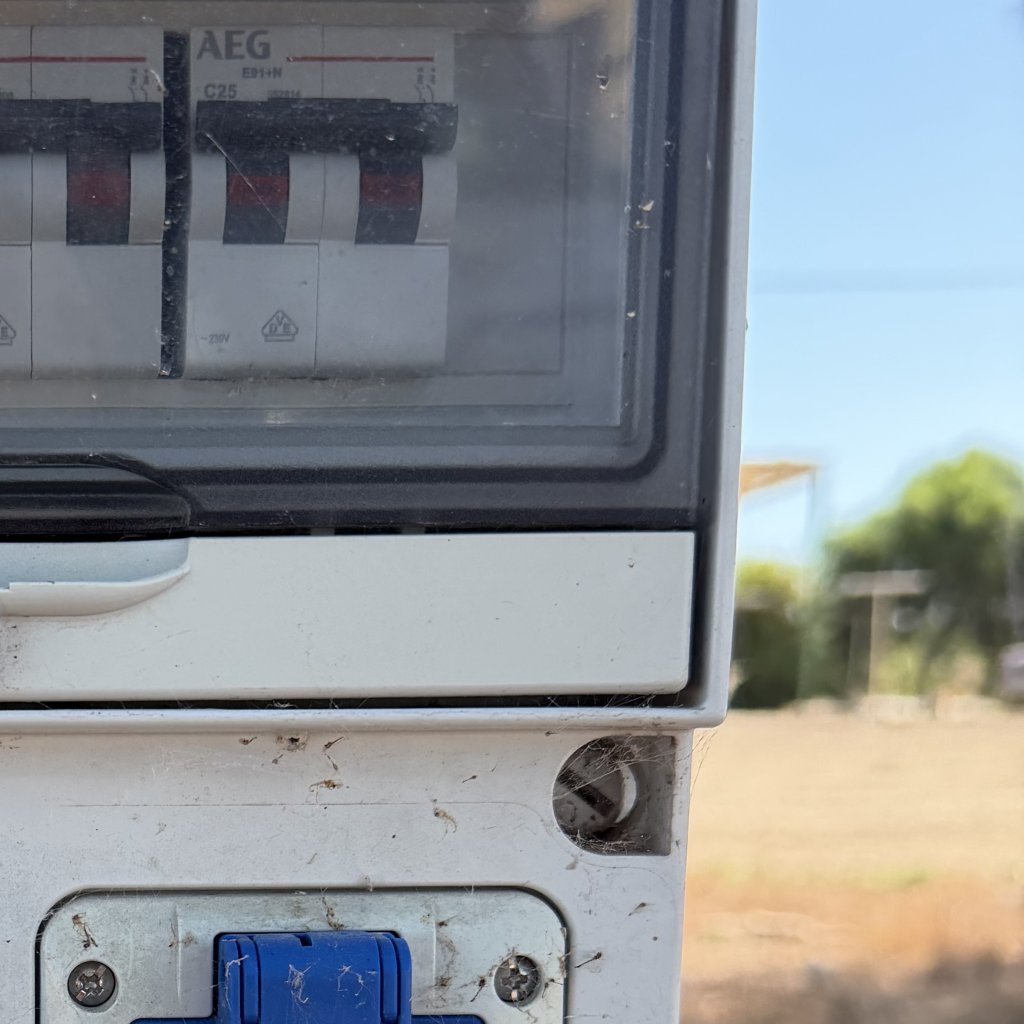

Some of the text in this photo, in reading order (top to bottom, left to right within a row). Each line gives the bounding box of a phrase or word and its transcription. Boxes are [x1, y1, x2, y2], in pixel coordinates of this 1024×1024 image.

[197, 30, 271, 60] AEG
[242, 67, 282, 79] E91+N
[204, 84, 237, 99] C25
